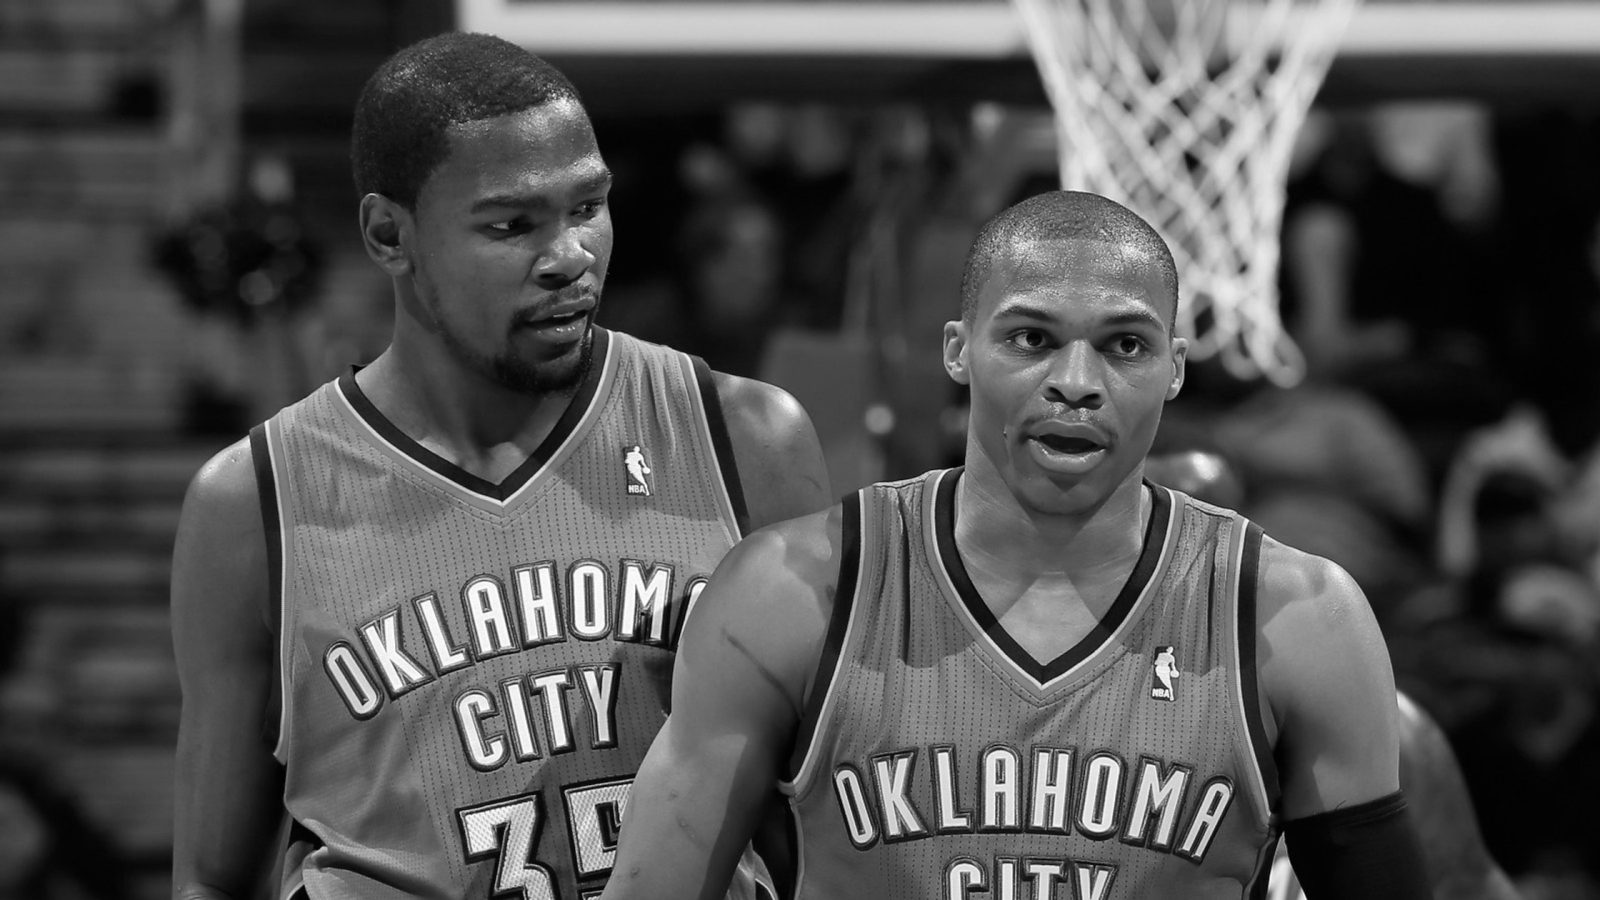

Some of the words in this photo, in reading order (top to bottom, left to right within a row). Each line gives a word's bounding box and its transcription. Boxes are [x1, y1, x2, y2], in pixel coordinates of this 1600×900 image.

[628, 484, 646, 494] NBA
[453, 662, 621, 772] CITY
[1152, 687, 1170, 698] NBA
[832, 742, 1235, 865] OKLAHOMA
